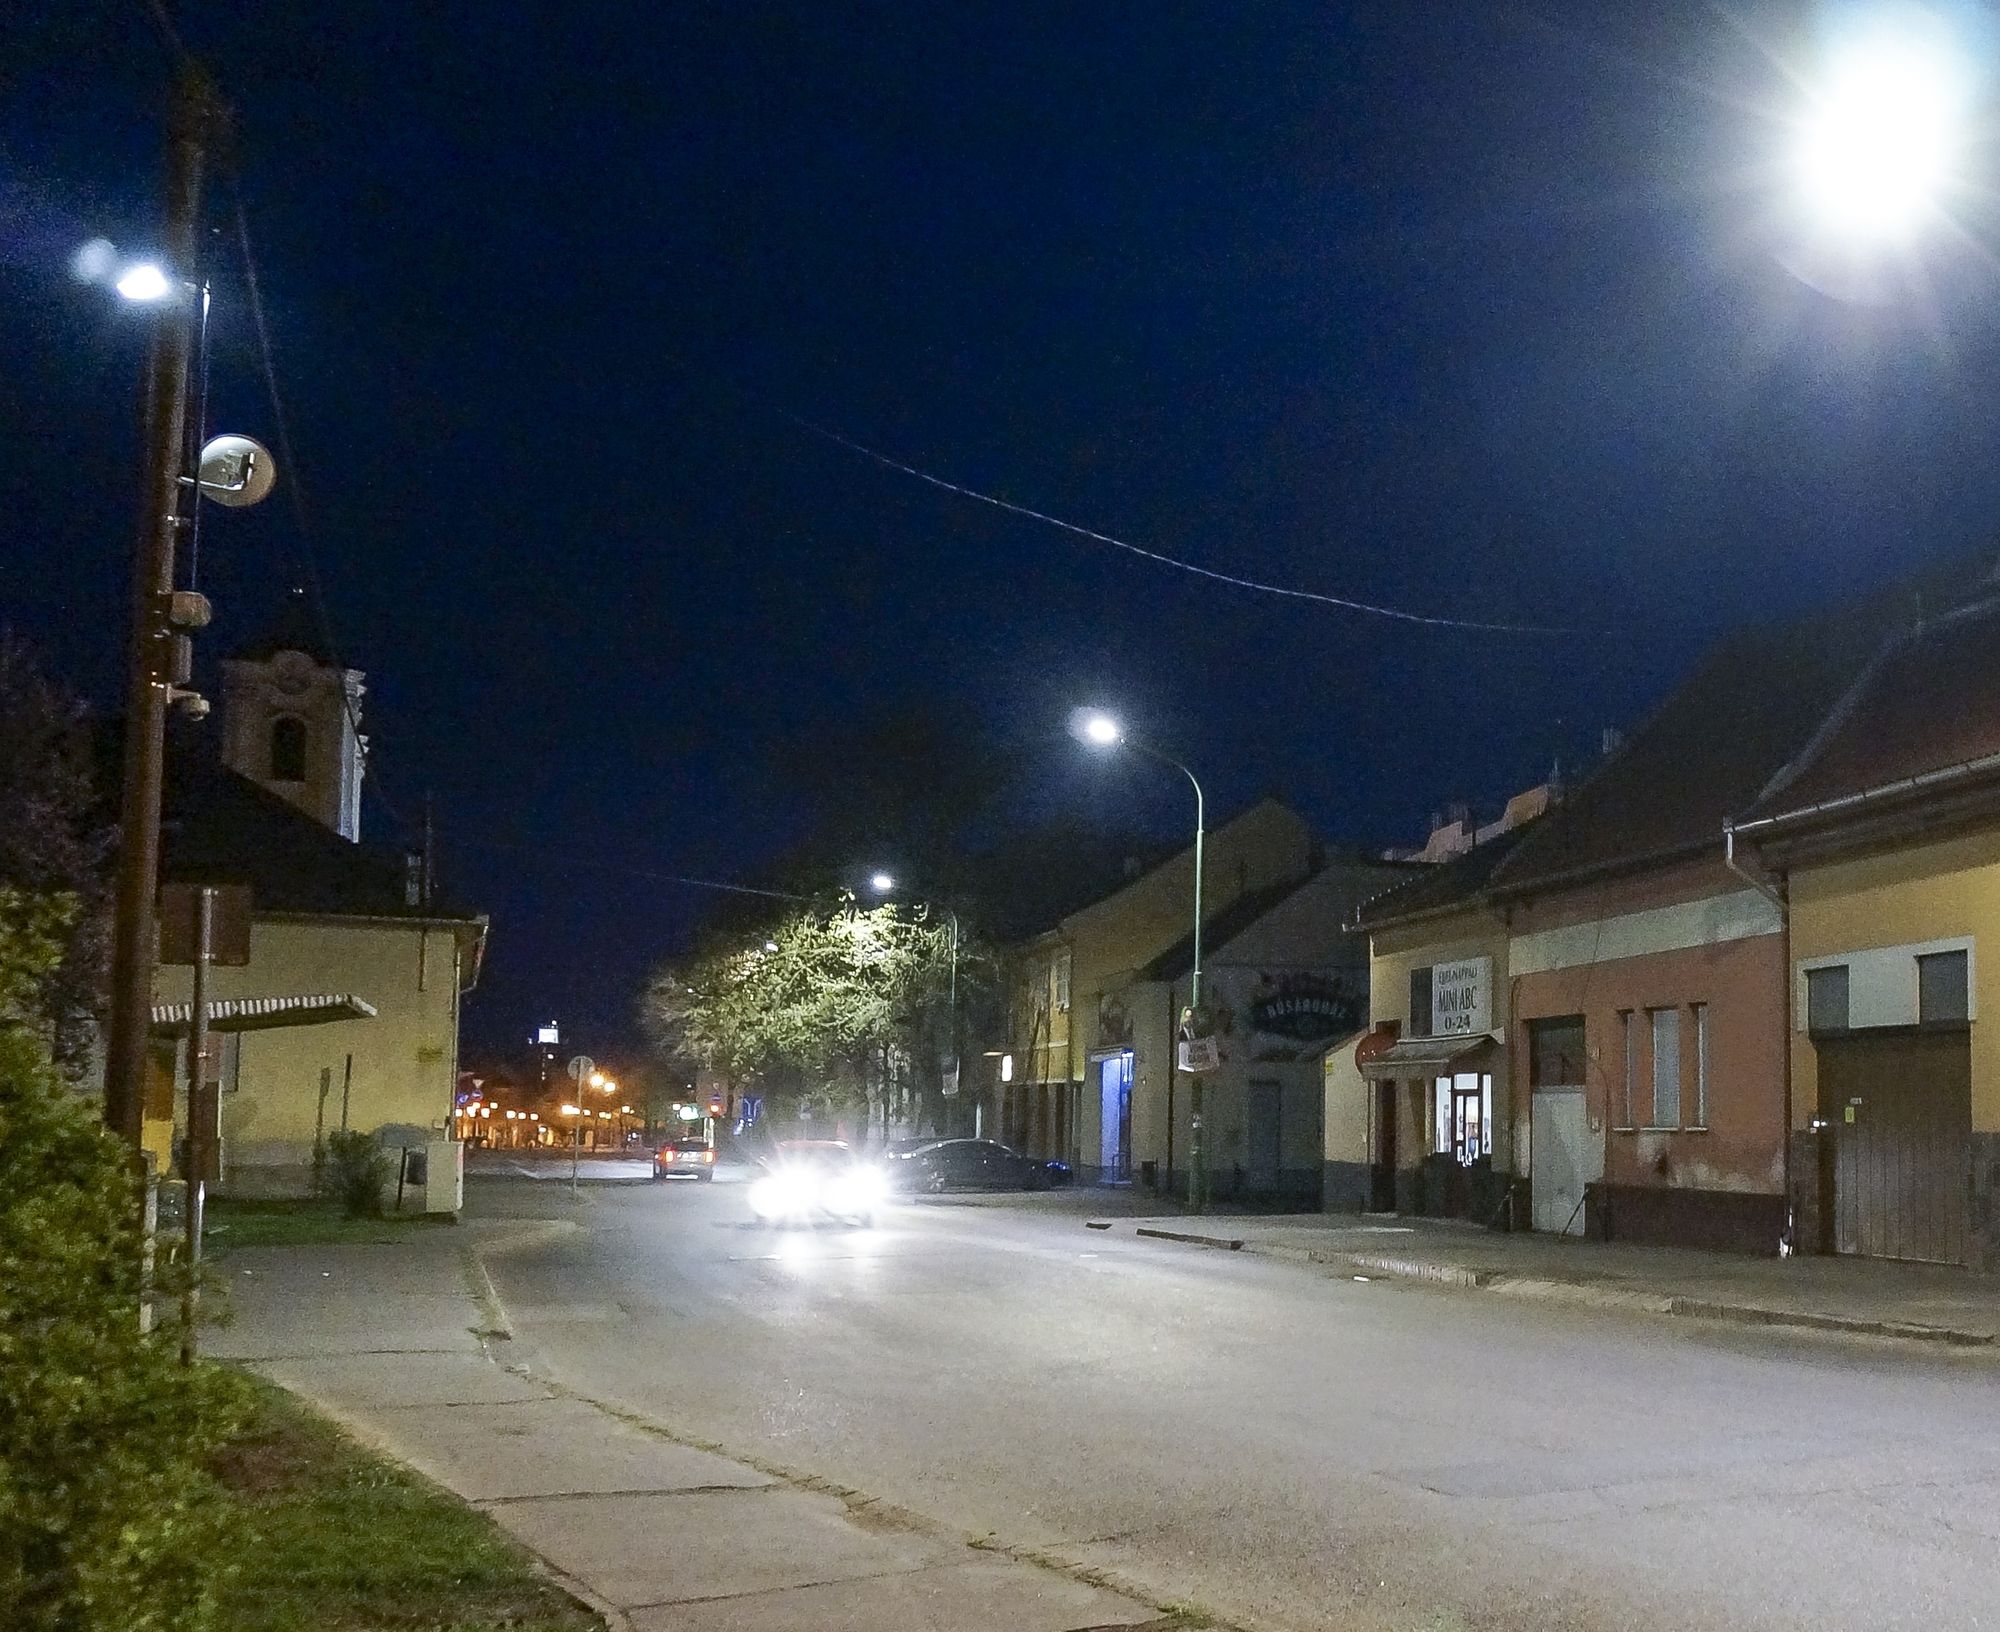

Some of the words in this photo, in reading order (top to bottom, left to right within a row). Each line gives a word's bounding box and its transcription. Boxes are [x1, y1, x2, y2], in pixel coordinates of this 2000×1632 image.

[1439, 988, 1458, 1012] MINI
[1459, 985, 1477, 1010] ABC
[1445, 1014, 1471, 1030] 0-24
